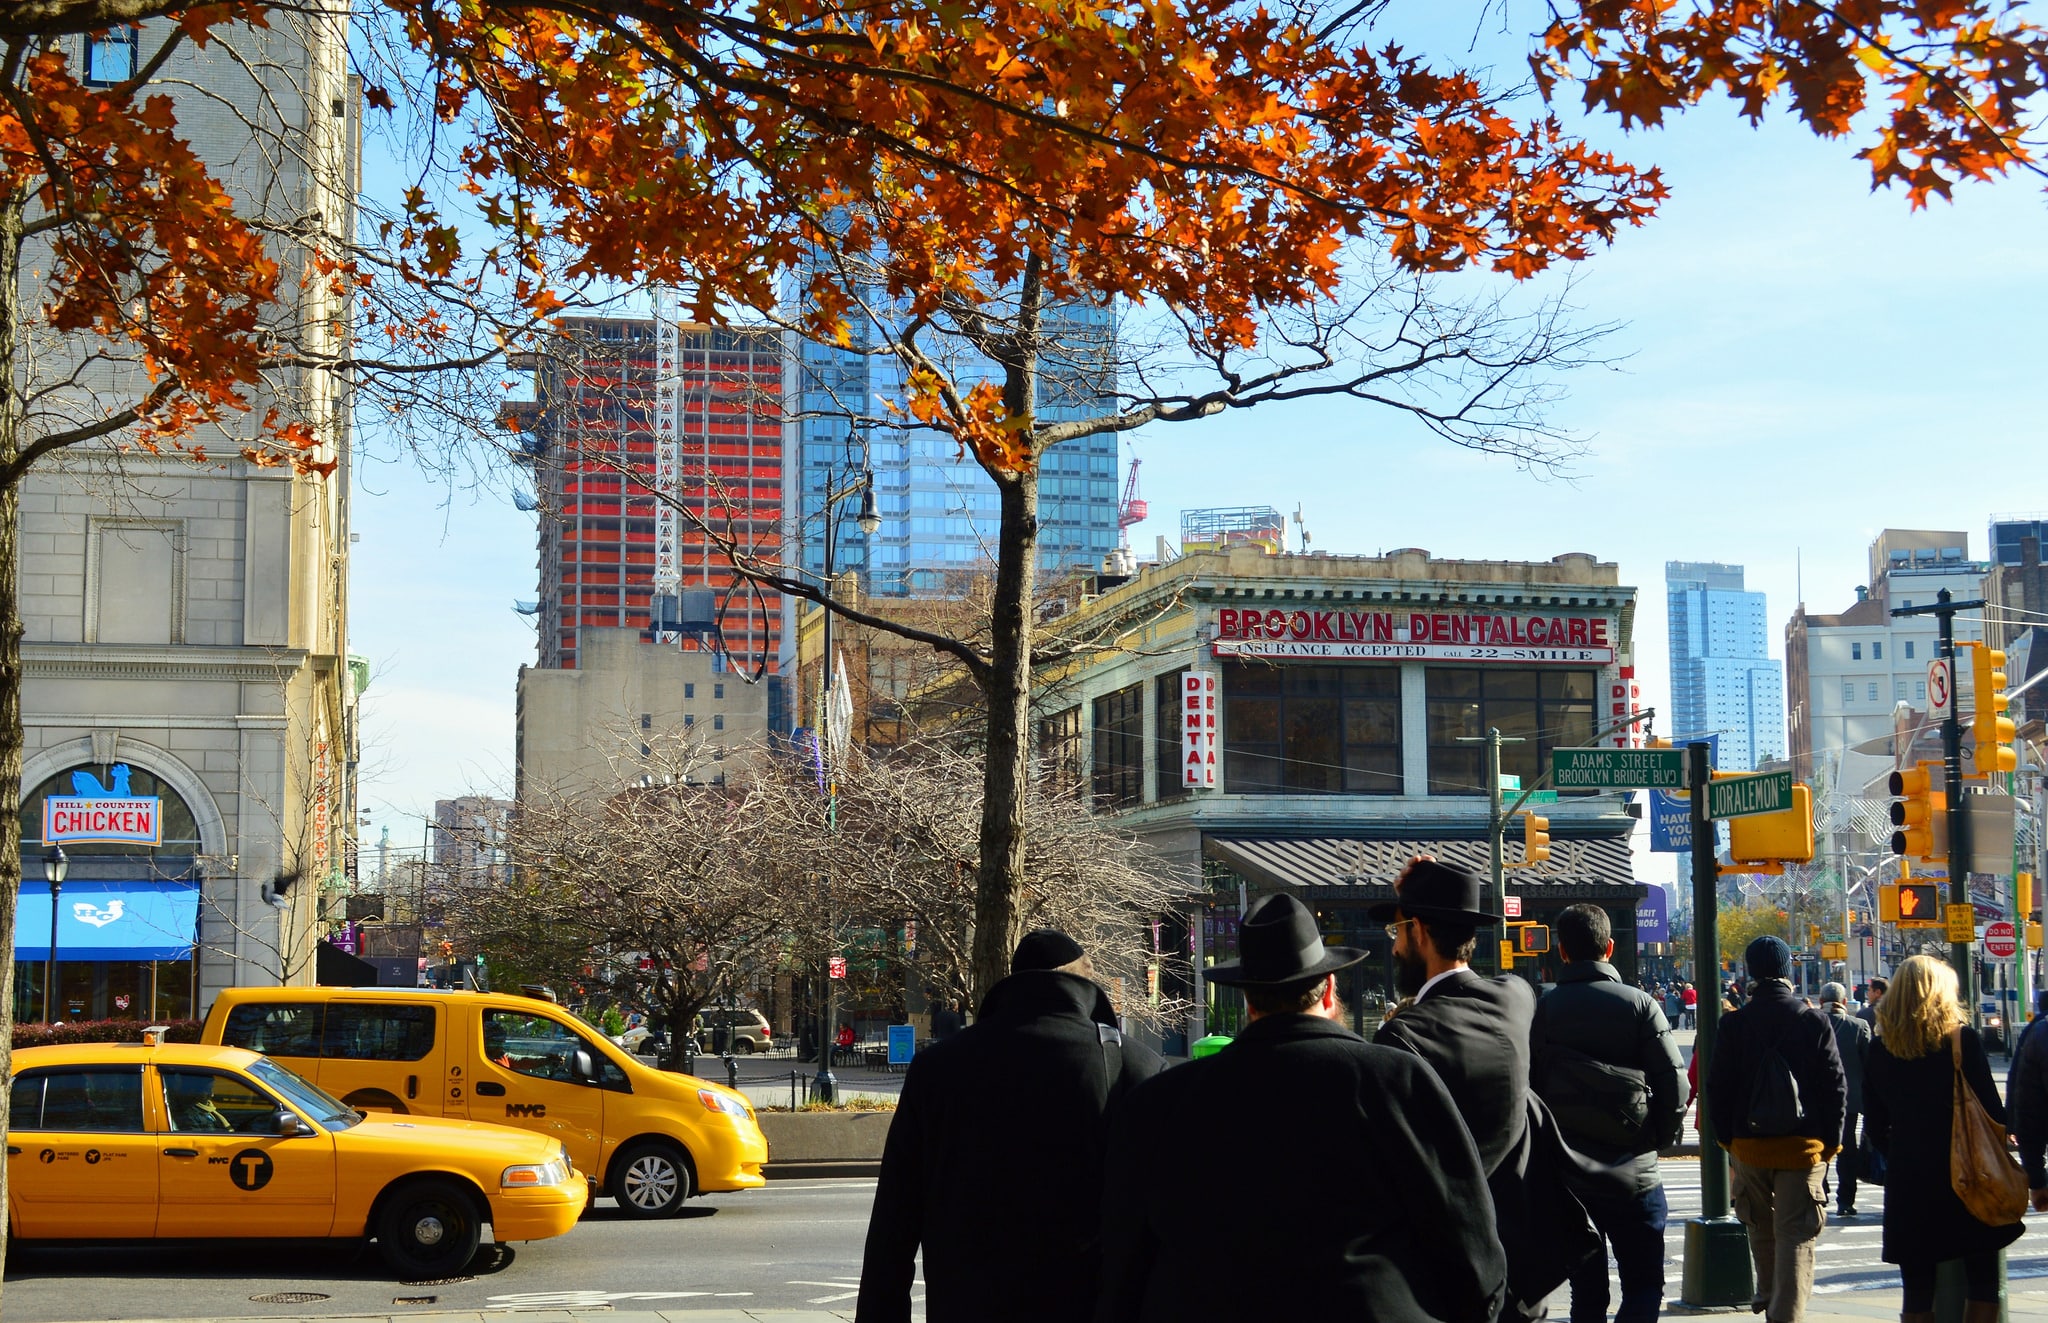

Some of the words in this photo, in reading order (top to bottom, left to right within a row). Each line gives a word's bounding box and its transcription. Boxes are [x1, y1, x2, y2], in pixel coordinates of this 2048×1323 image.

[1219, 609, 1393, 640] BROOKLYN
[1409, 613, 1609, 646] DENTALCARE
[1237, 643, 1331, 656] INSURANCE
[1342, 645, 1426, 657] ACCEPTED
[1187, 678, 1201, 783] DENTAL
[1206, 678, 1215, 783] DENTAL
[1612, 685, 1627, 748] DENT
[1631, 685, 1640, 749] DENT
[1572, 754, 1612, 768] ADAMS
[1621, 754, 1663, 768] STREET
[1559, 769, 1609, 783] BROOKLYN
[1614, 769, 1648, 783] BRIDGE
[1653, 770, 1676, 784] BLVD
[1713, 777, 1779, 815] JORALEMON
[1781, 775, 1789, 791] ST
[54, 811, 150, 833] CHICKEN
[1667, 825, 1692, 835] YOU
[1335, 841, 1457, 874] SHAKE
[1312, 886, 1375, 899] BURGERS
[505, 1104, 546, 1118] NYC
[241, 1157, 264, 1186] T
